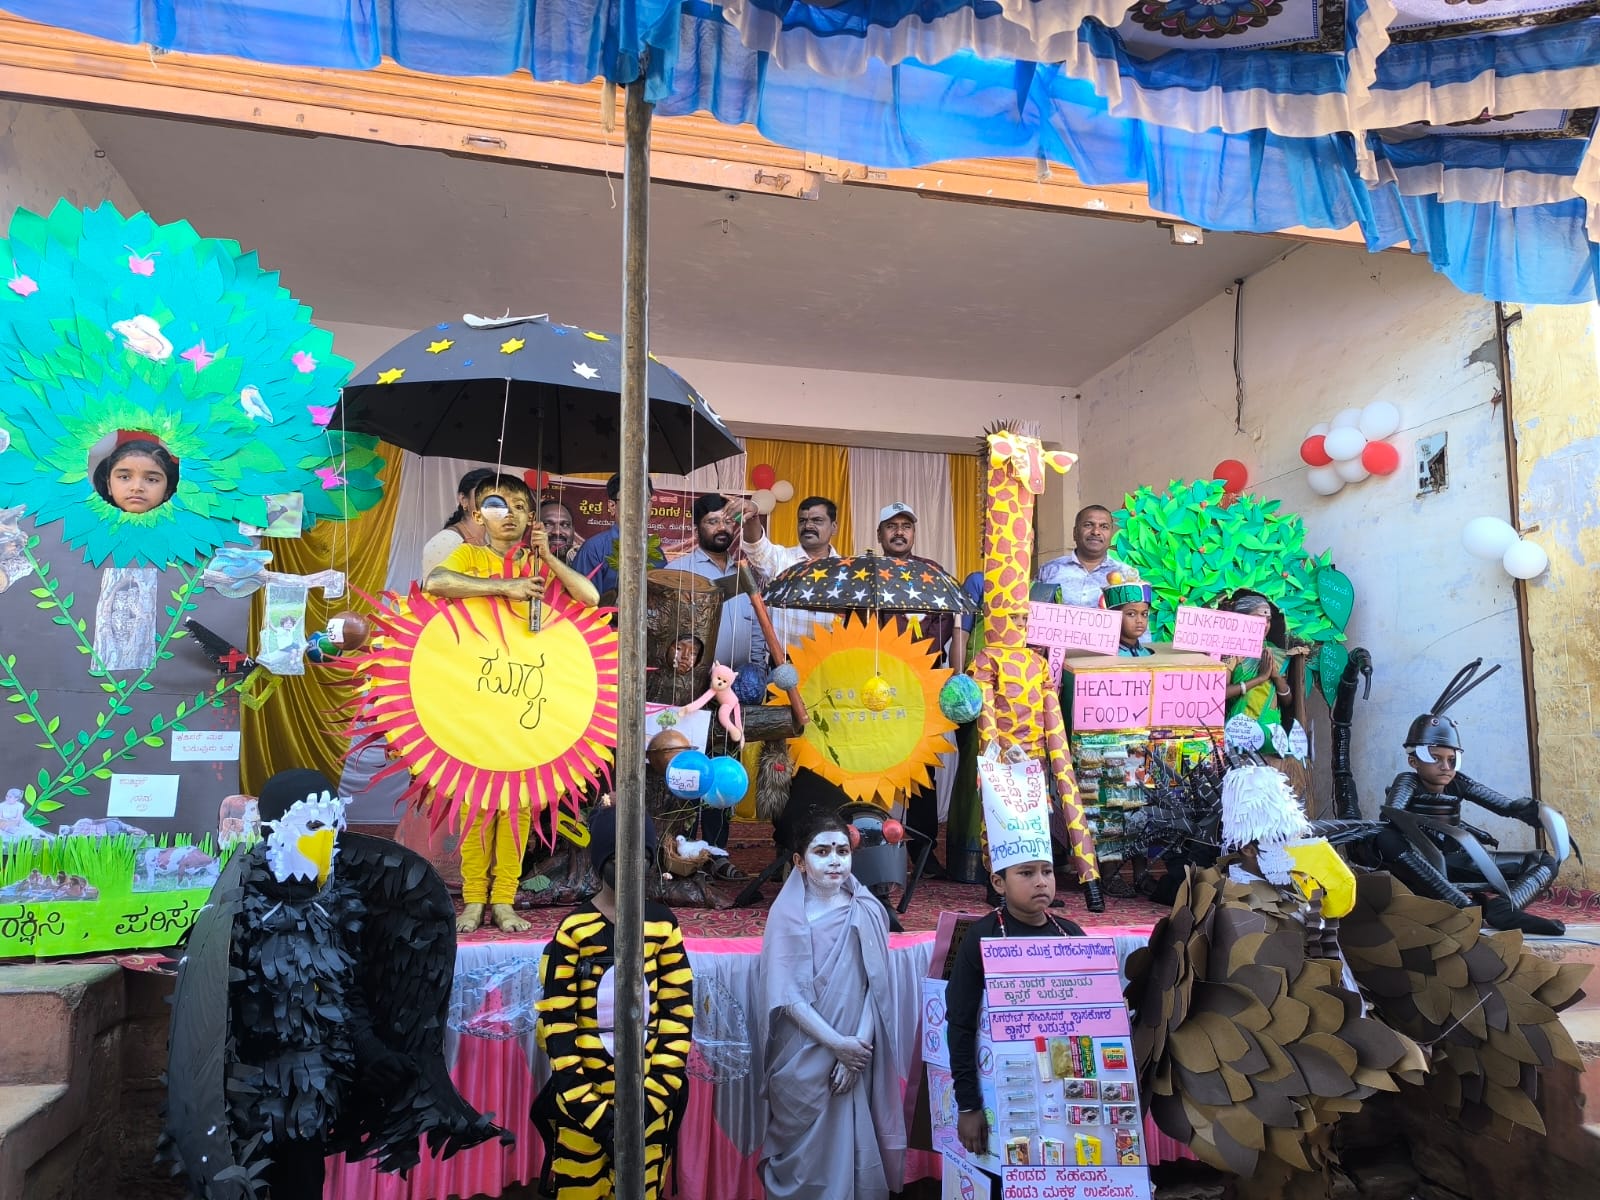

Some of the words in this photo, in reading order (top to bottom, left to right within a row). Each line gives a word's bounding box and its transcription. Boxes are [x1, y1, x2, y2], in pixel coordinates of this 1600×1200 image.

[579, 499, 603, 515] ಕ್ಷೇತ್ರ
[1242, 620, 1266, 635] NOT
[1175, 630, 1199, 646] GOOD
[1076, 679, 1150, 698] HEALTHY
[1162, 673, 1225, 691] JUNK
[1083, 706, 1129, 723] FOOD
[1160, 701, 1209, 719] FOOD
[1007, 815, 1046, 835] ಮುಕ್ತ
[984, 944, 1023, 958] ತಂಬಾಕು
[1026, 943, 1053, 959] ಮುಕ್ತ
[1005, 1168, 1046, 1182] ಹೆಂಡದ
